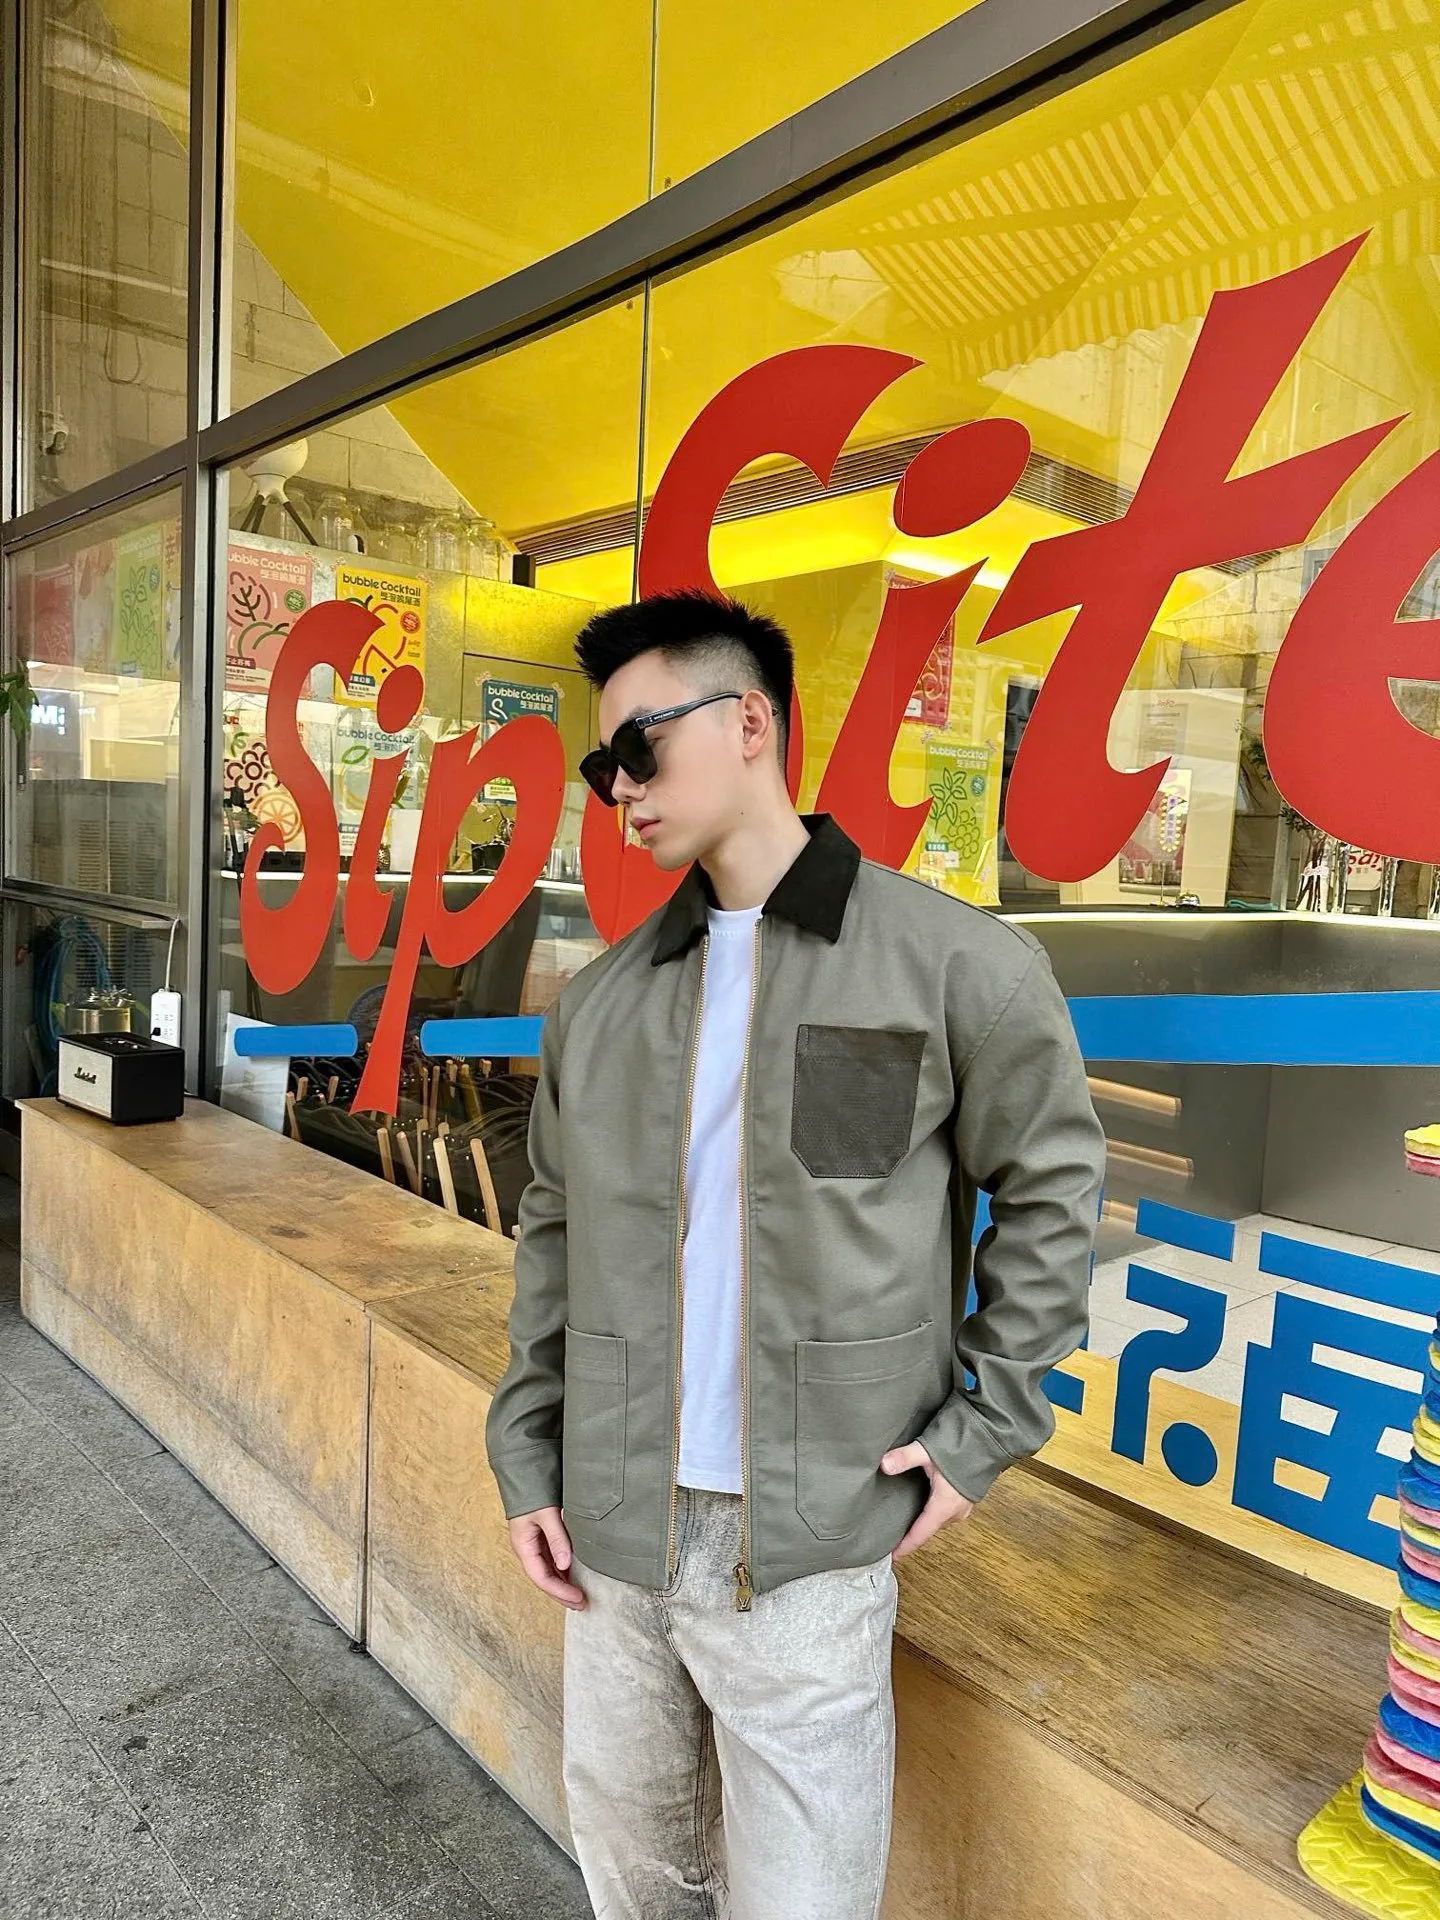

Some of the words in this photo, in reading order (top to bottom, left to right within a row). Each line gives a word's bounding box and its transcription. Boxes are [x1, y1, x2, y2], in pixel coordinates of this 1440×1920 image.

[228, 552, 259, 567] ubble
[259, 558, 307, 575] Cocktail
[342, 573, 380, 589] bubble
[380, 580, 421, 597] Cocktail
[488, 685, 520, 699] bubble
[520, 690, 555, 704] Cocktail
[929, 746, 956, 756] bubble
[956, 748, 988, 760] Cocktail
[240, 600, 566, 1117] Sip
